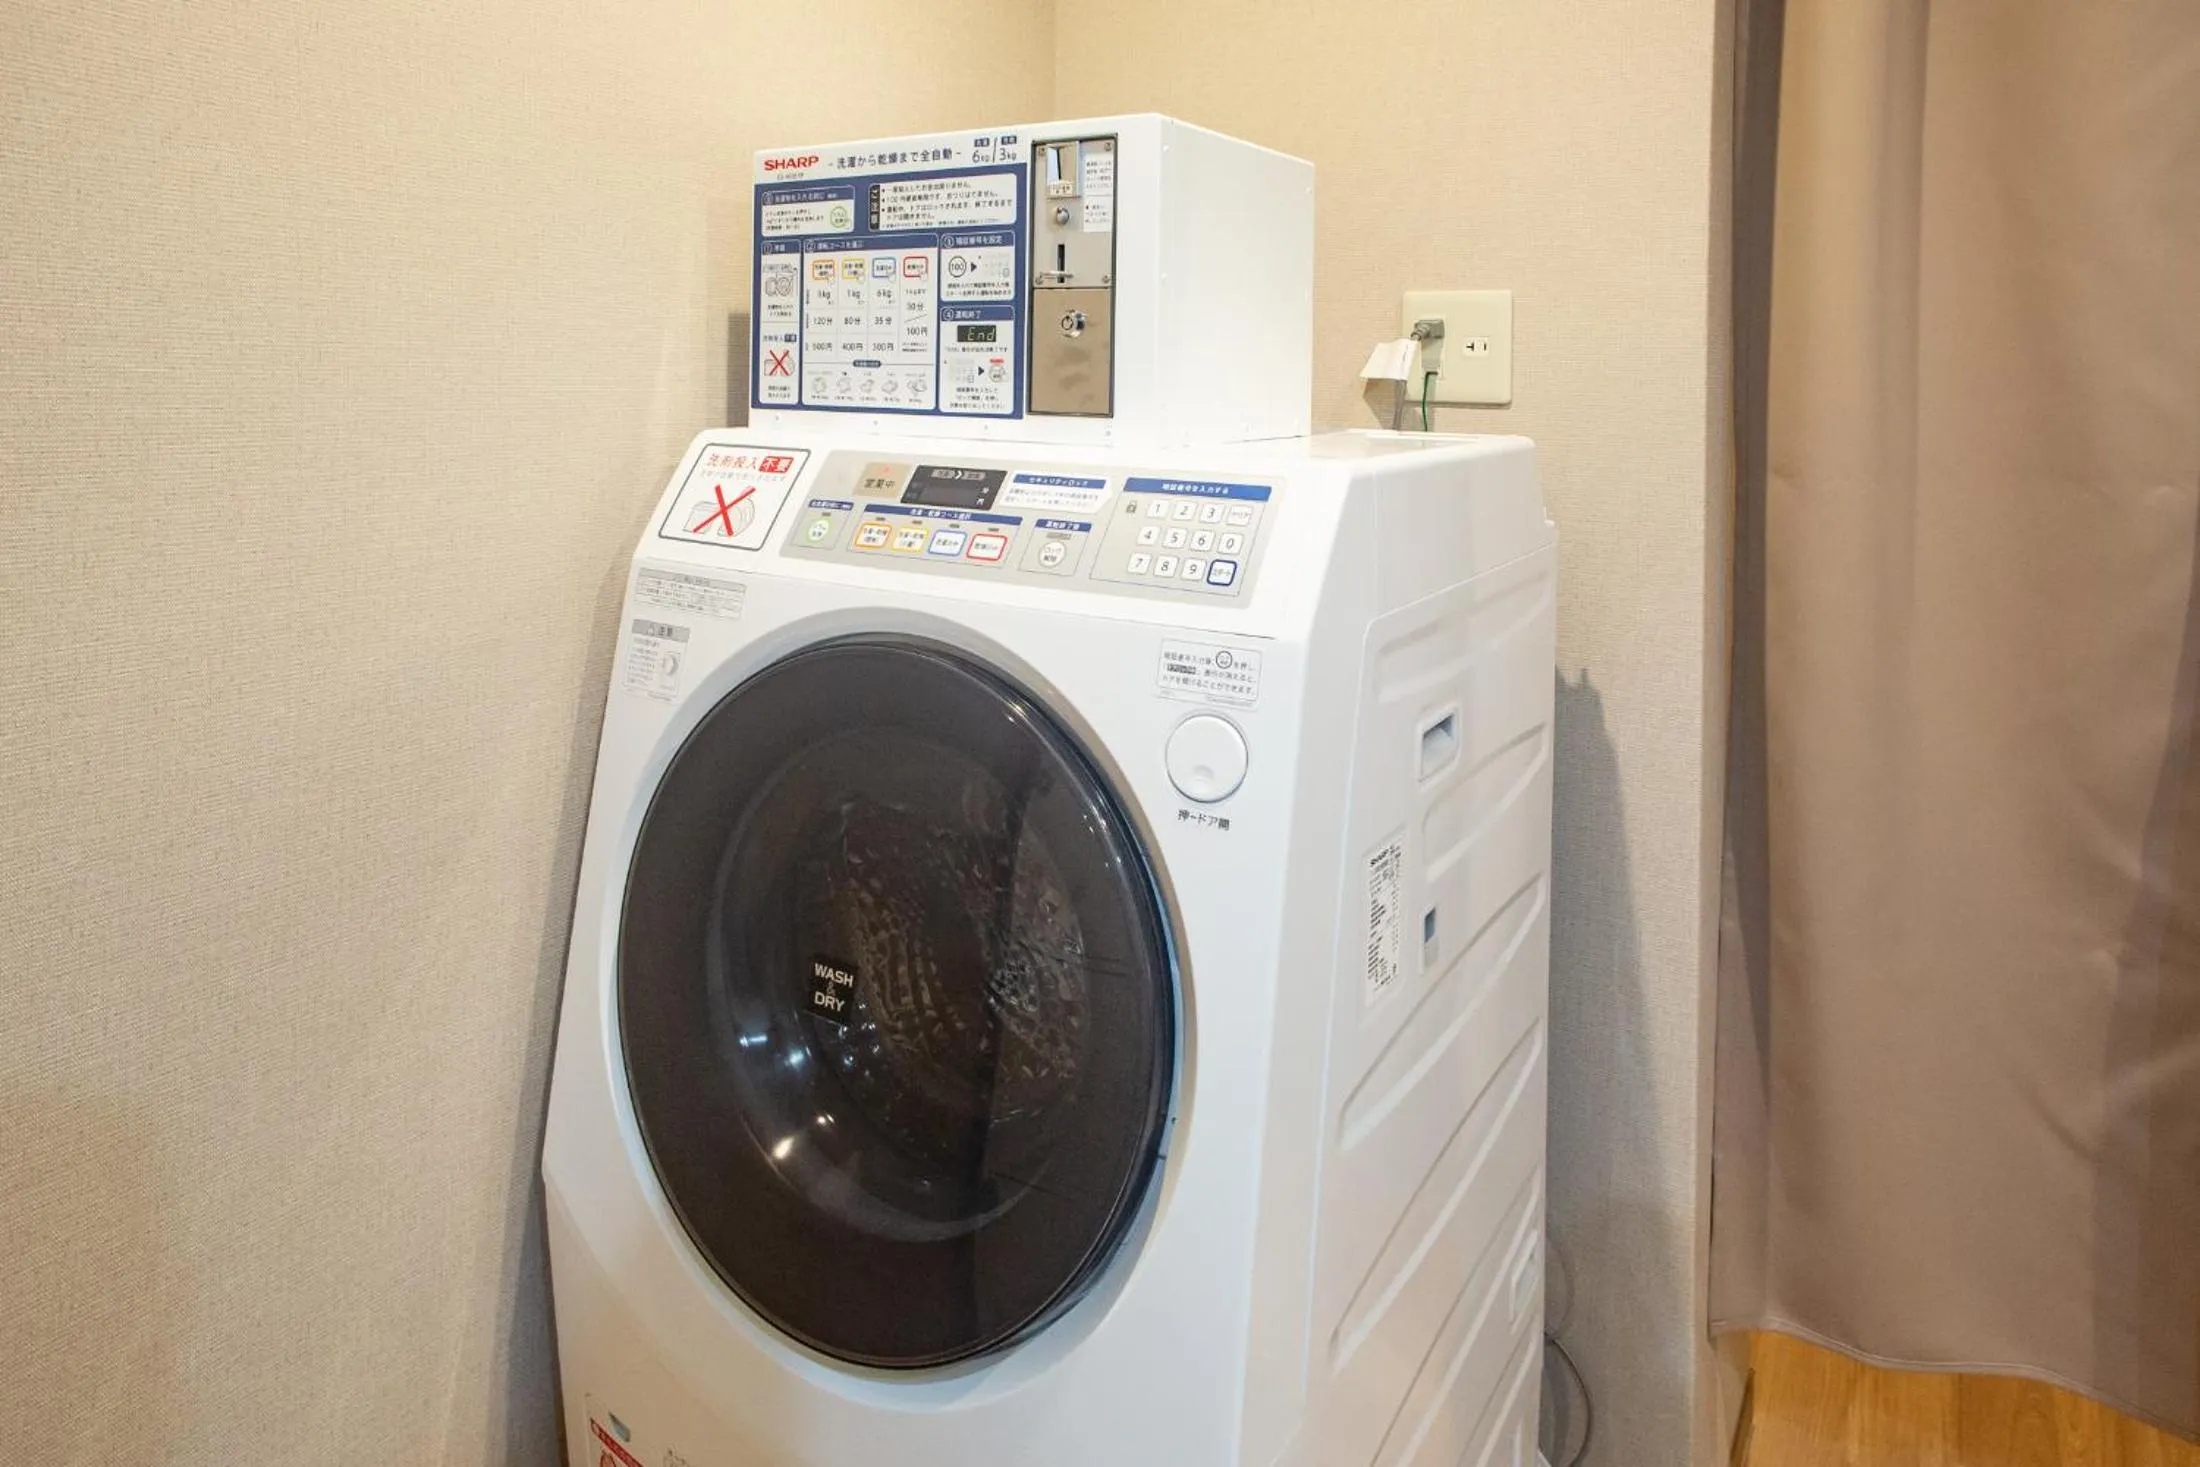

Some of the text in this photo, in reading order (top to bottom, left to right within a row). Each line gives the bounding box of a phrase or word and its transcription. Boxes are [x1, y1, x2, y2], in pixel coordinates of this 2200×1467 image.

[764, 154, 820, 171] SHARP
[967, 326, 996, 341] End
[705, 453, 794, 473] 洗剤投入不要
[864, 478, 896, 489] 営業中
[1029, 476, 1089, 487] セキュリティロック
[1162, 483, 1229, 495] 暗証番号を入力する
[1208, 507, 1216, 518] 3
[1171, 533, 1179, 544] 5
[1198, 536, 1206, 546] 6
[1226, 538, 1235, 549] 0
[1161, 561, 1169, 571] 8
[1189, 564, 1197, 575] 9
[814, 962, 854, 988] WASH
[814, 990, 845, 1012] DRY
